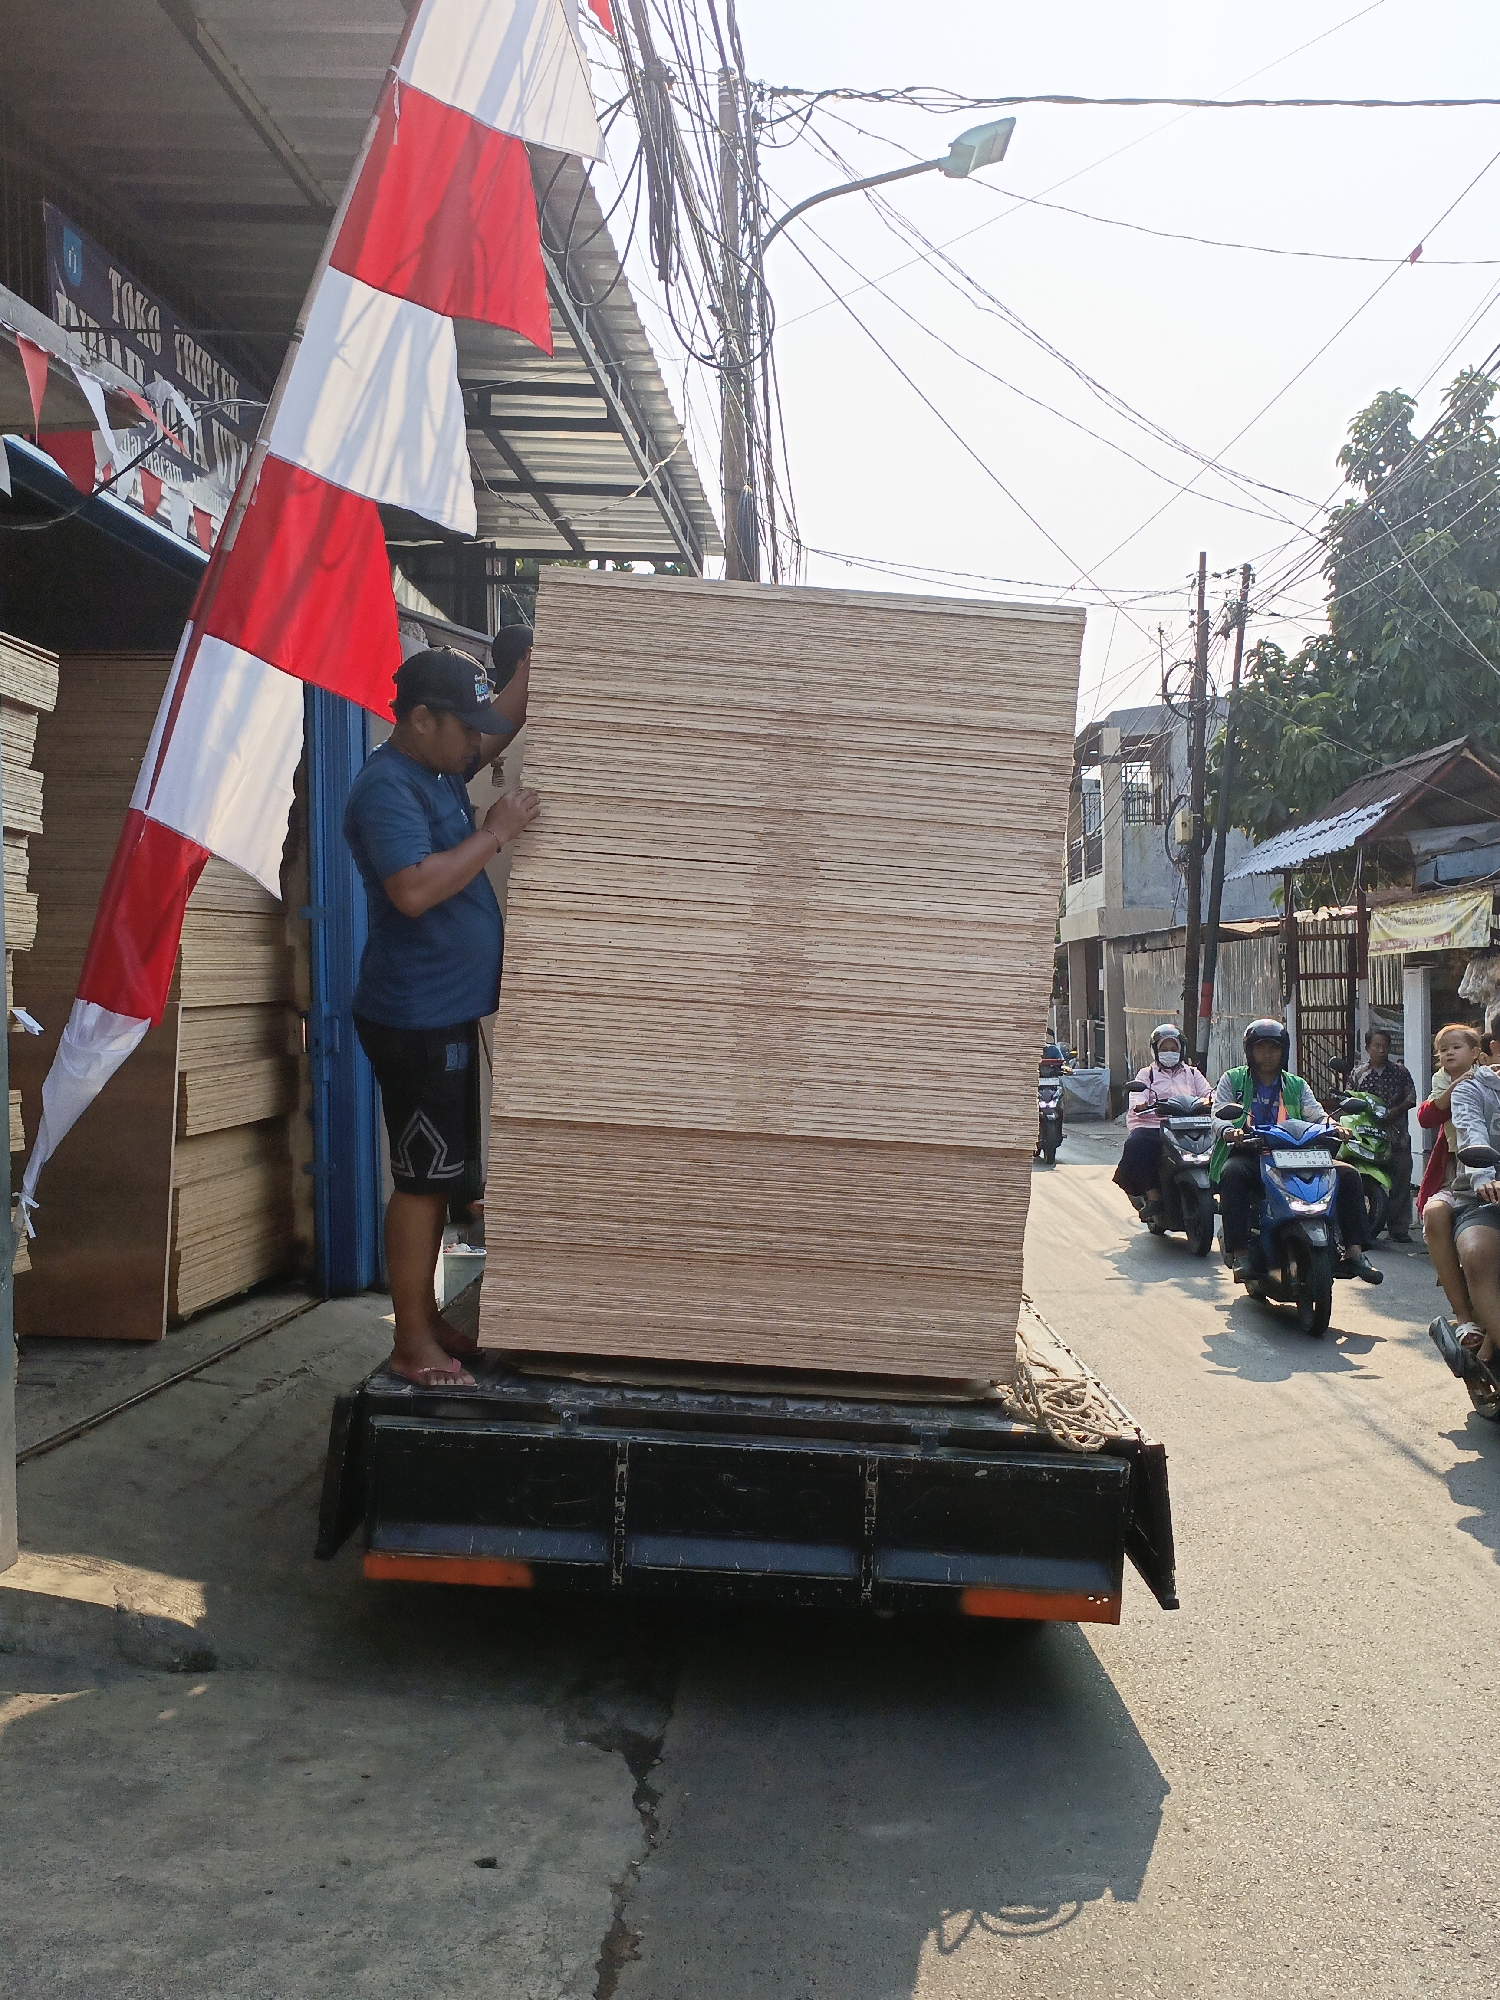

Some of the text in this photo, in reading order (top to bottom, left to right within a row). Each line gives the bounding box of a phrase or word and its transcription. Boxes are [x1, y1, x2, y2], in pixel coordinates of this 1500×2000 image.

[108, 266, 240, 425] TOKO TRIPLEK
[1278, 942, 1287, 955] RT
